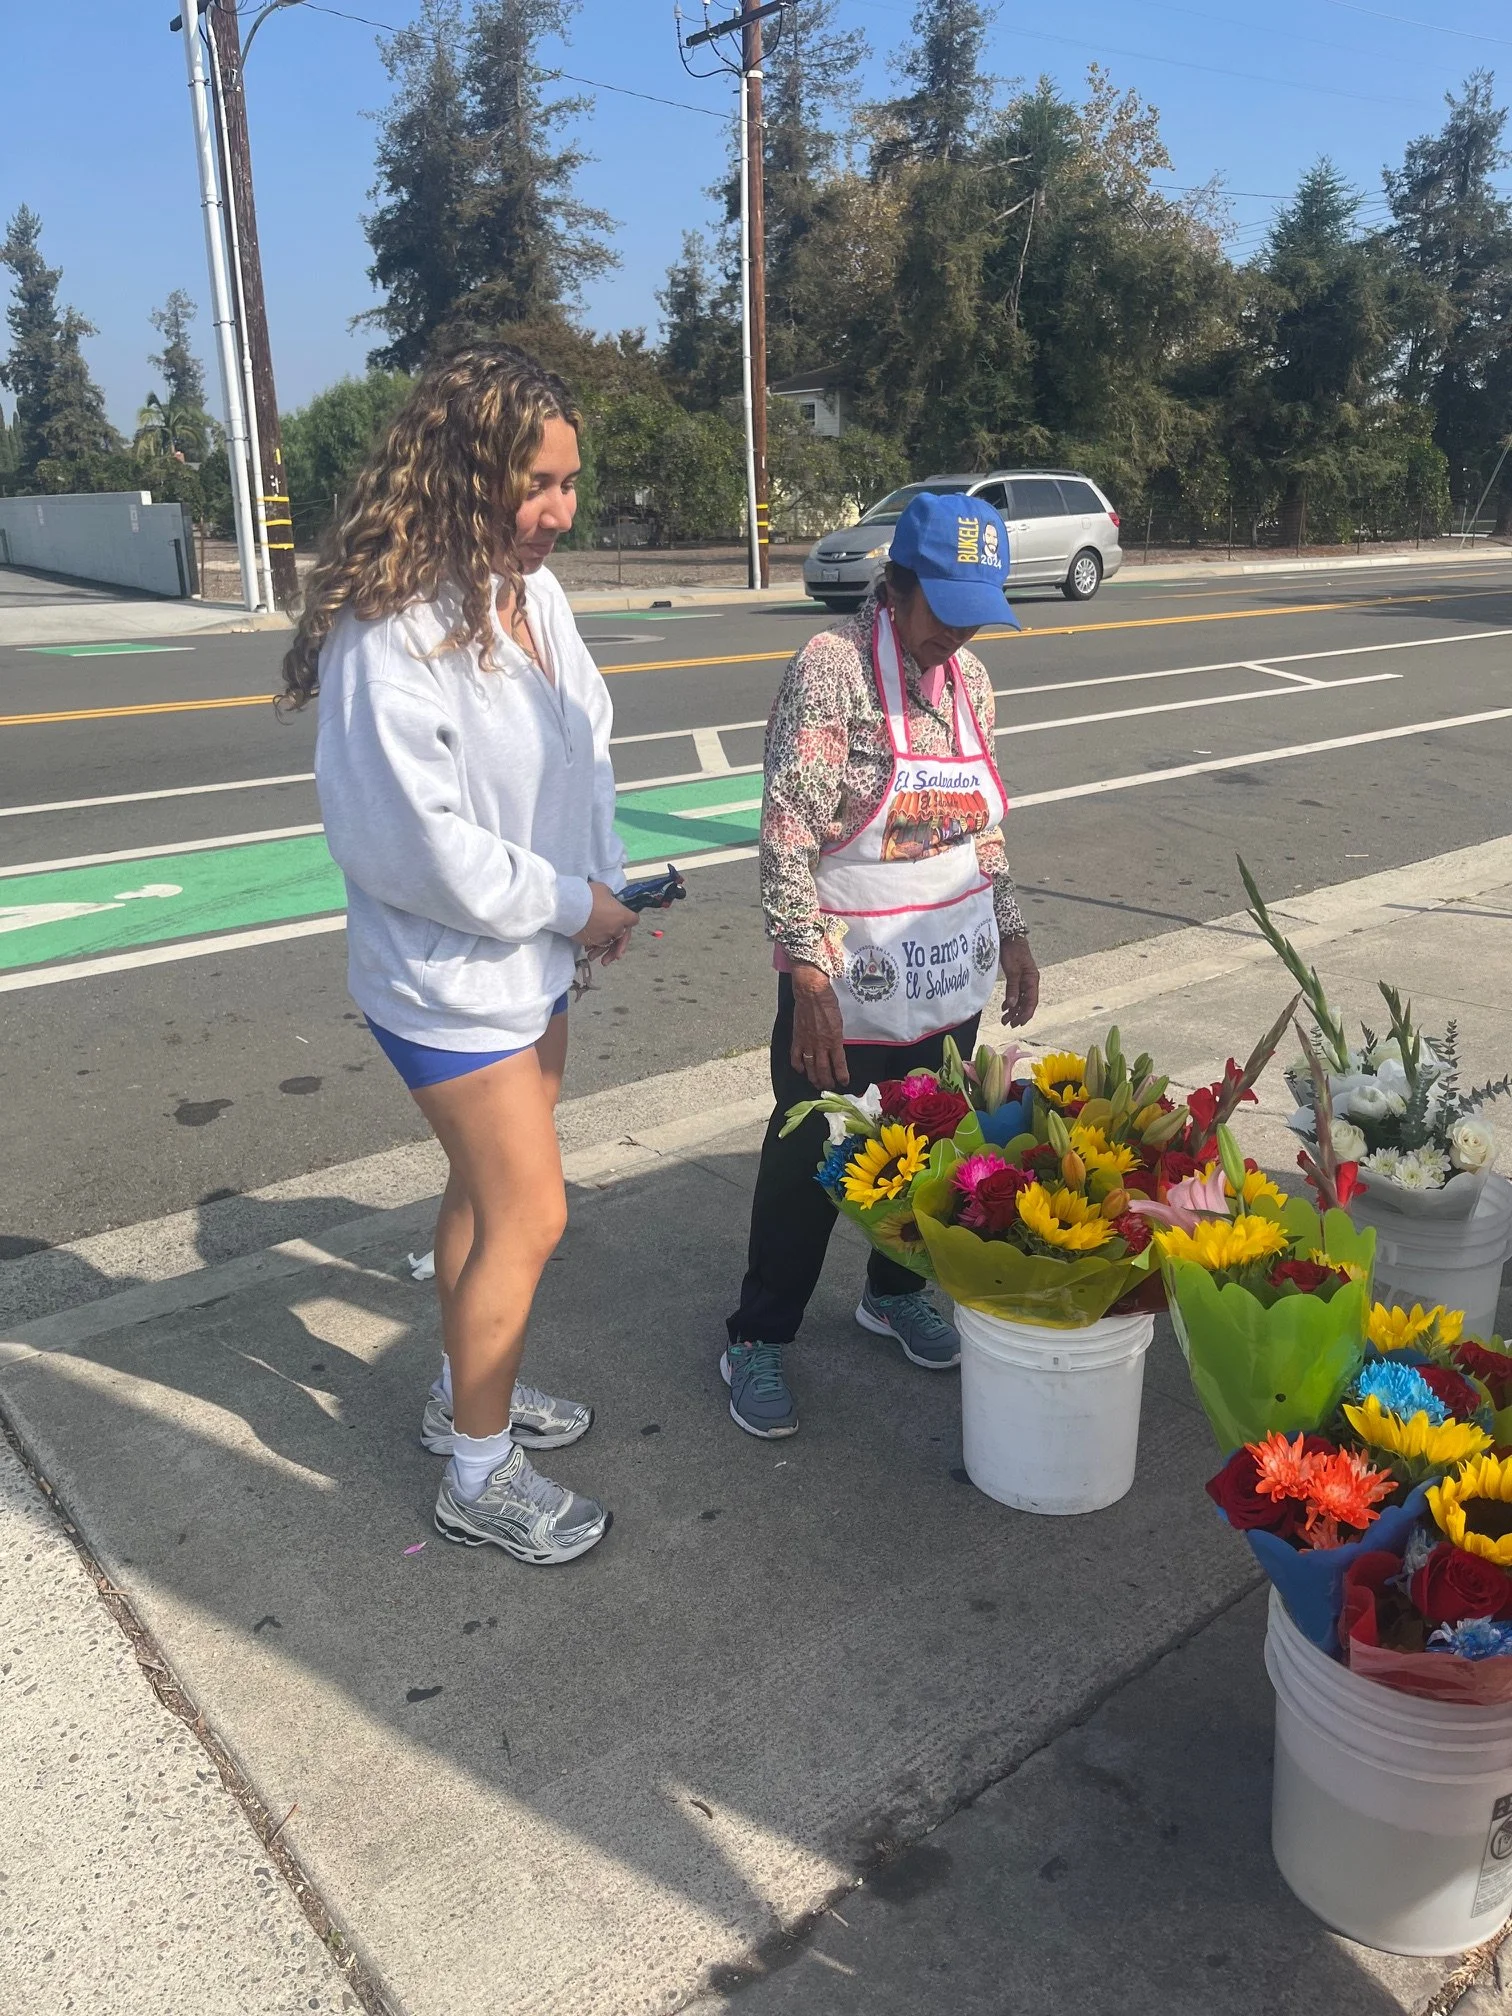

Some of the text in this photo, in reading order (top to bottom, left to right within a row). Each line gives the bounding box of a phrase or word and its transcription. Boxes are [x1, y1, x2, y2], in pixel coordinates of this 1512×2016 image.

[957, 516, 979, 563] BUKELE
[980, 554, 1002, 570] 2024
[894, 770, 981, 792] El Salvador
[901, 940, 926, 968] Yo
[930, 938, 959, 966] amo
[959, 933, 968, 955] a
[906, 963, 970, 1000] El Salvador
